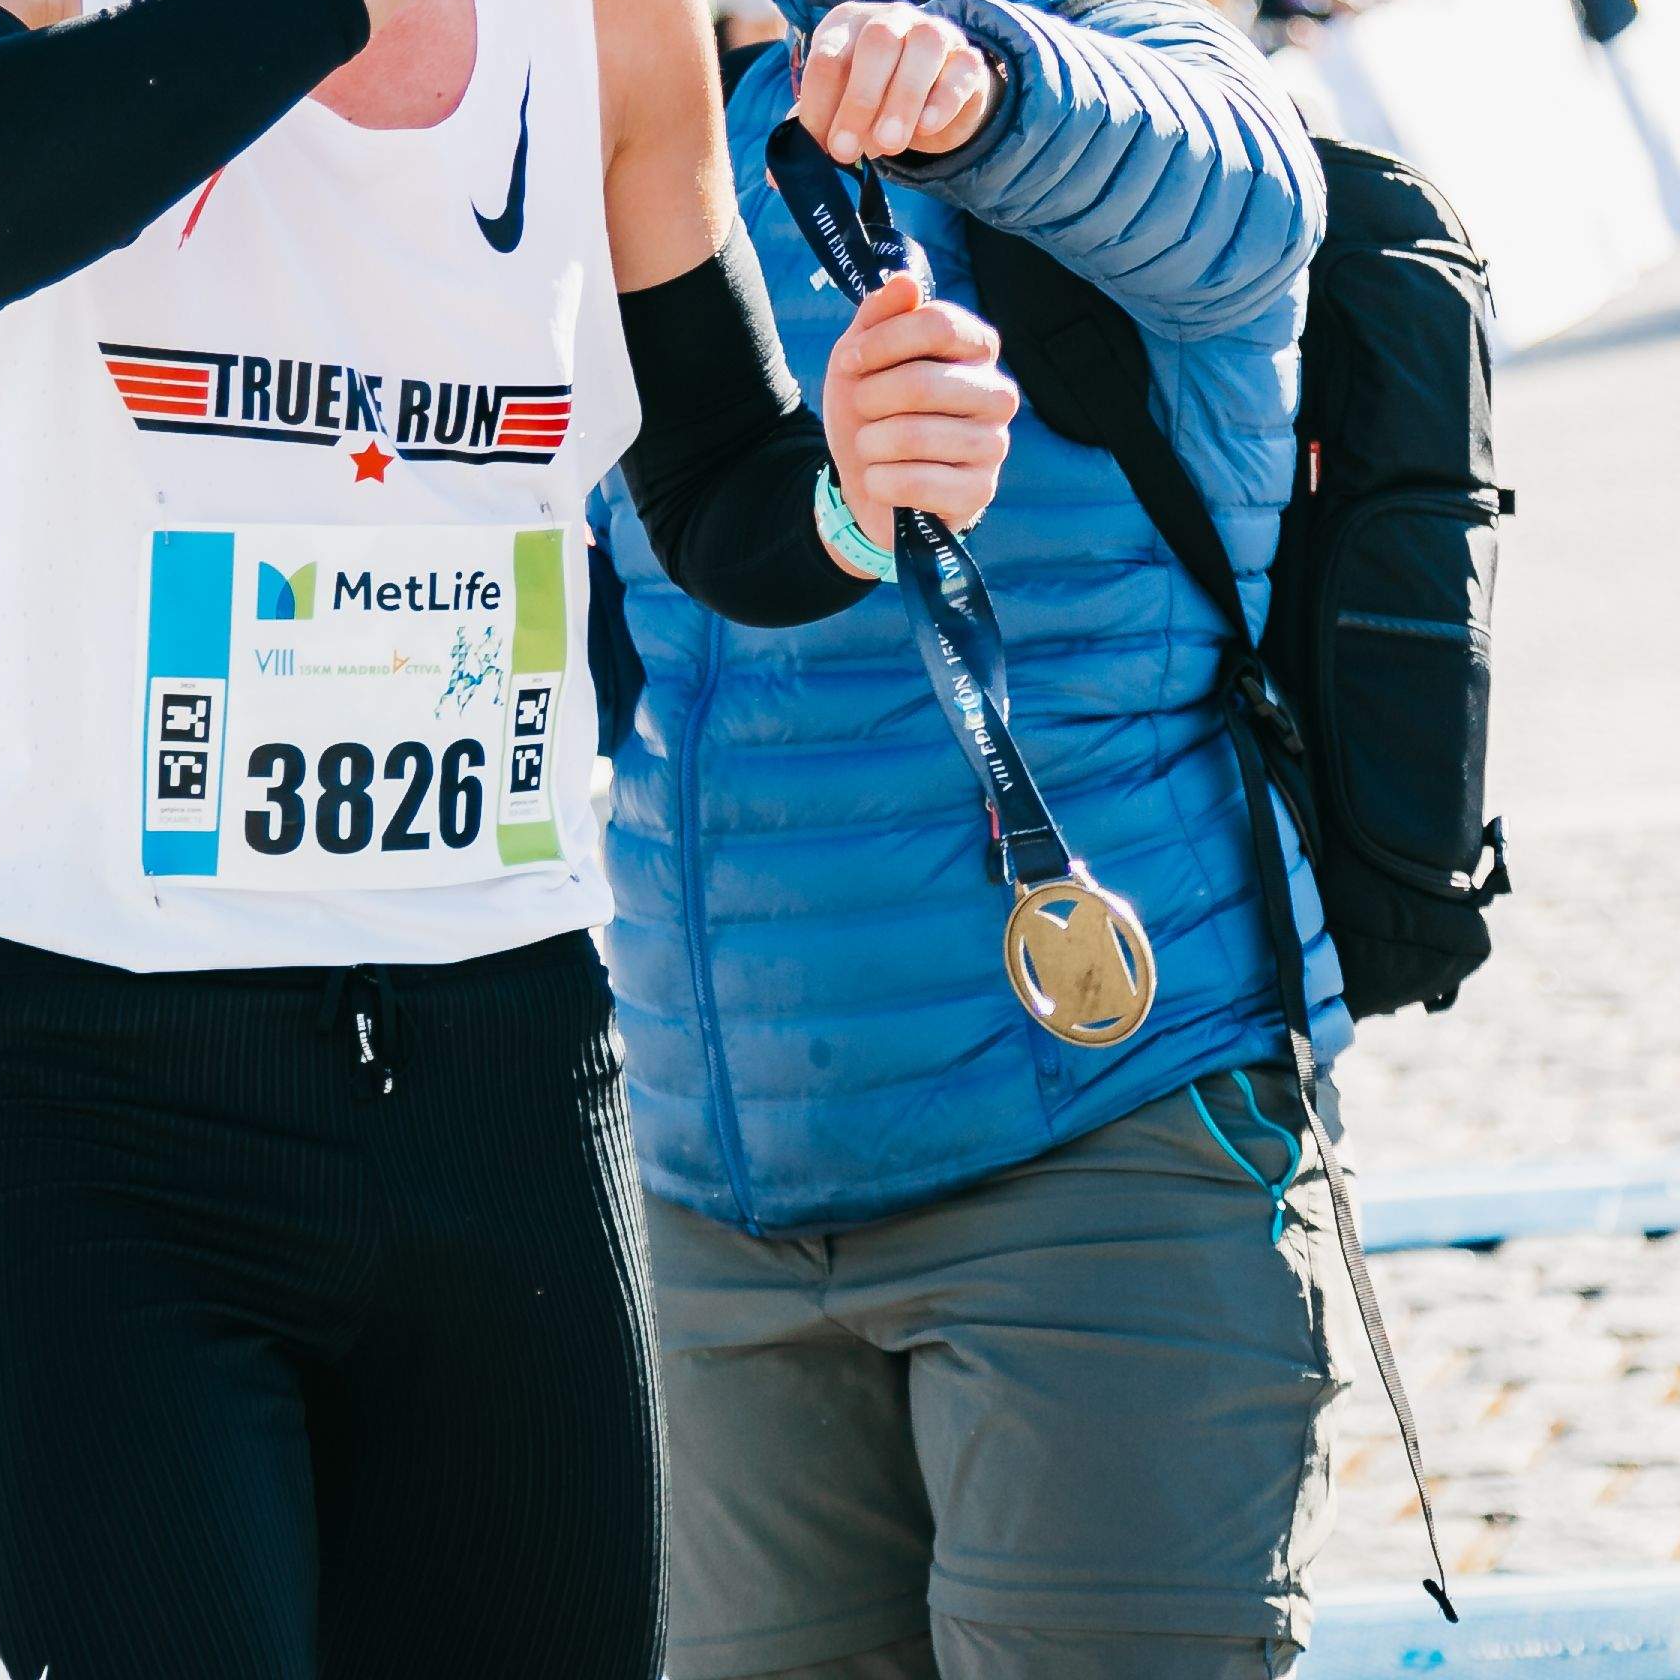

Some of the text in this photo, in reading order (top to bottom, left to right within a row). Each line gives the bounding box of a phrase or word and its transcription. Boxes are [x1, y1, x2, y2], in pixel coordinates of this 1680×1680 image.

[396, 378, 504, 448] RUN
[332, 570, 502, 613] MetLife
[254, 648, 295, 676] VIII
[298, 665, 332, 676] 15KM
[336, 665, 390, 676] MADRID
[244, 738, 486, 856] 3826
